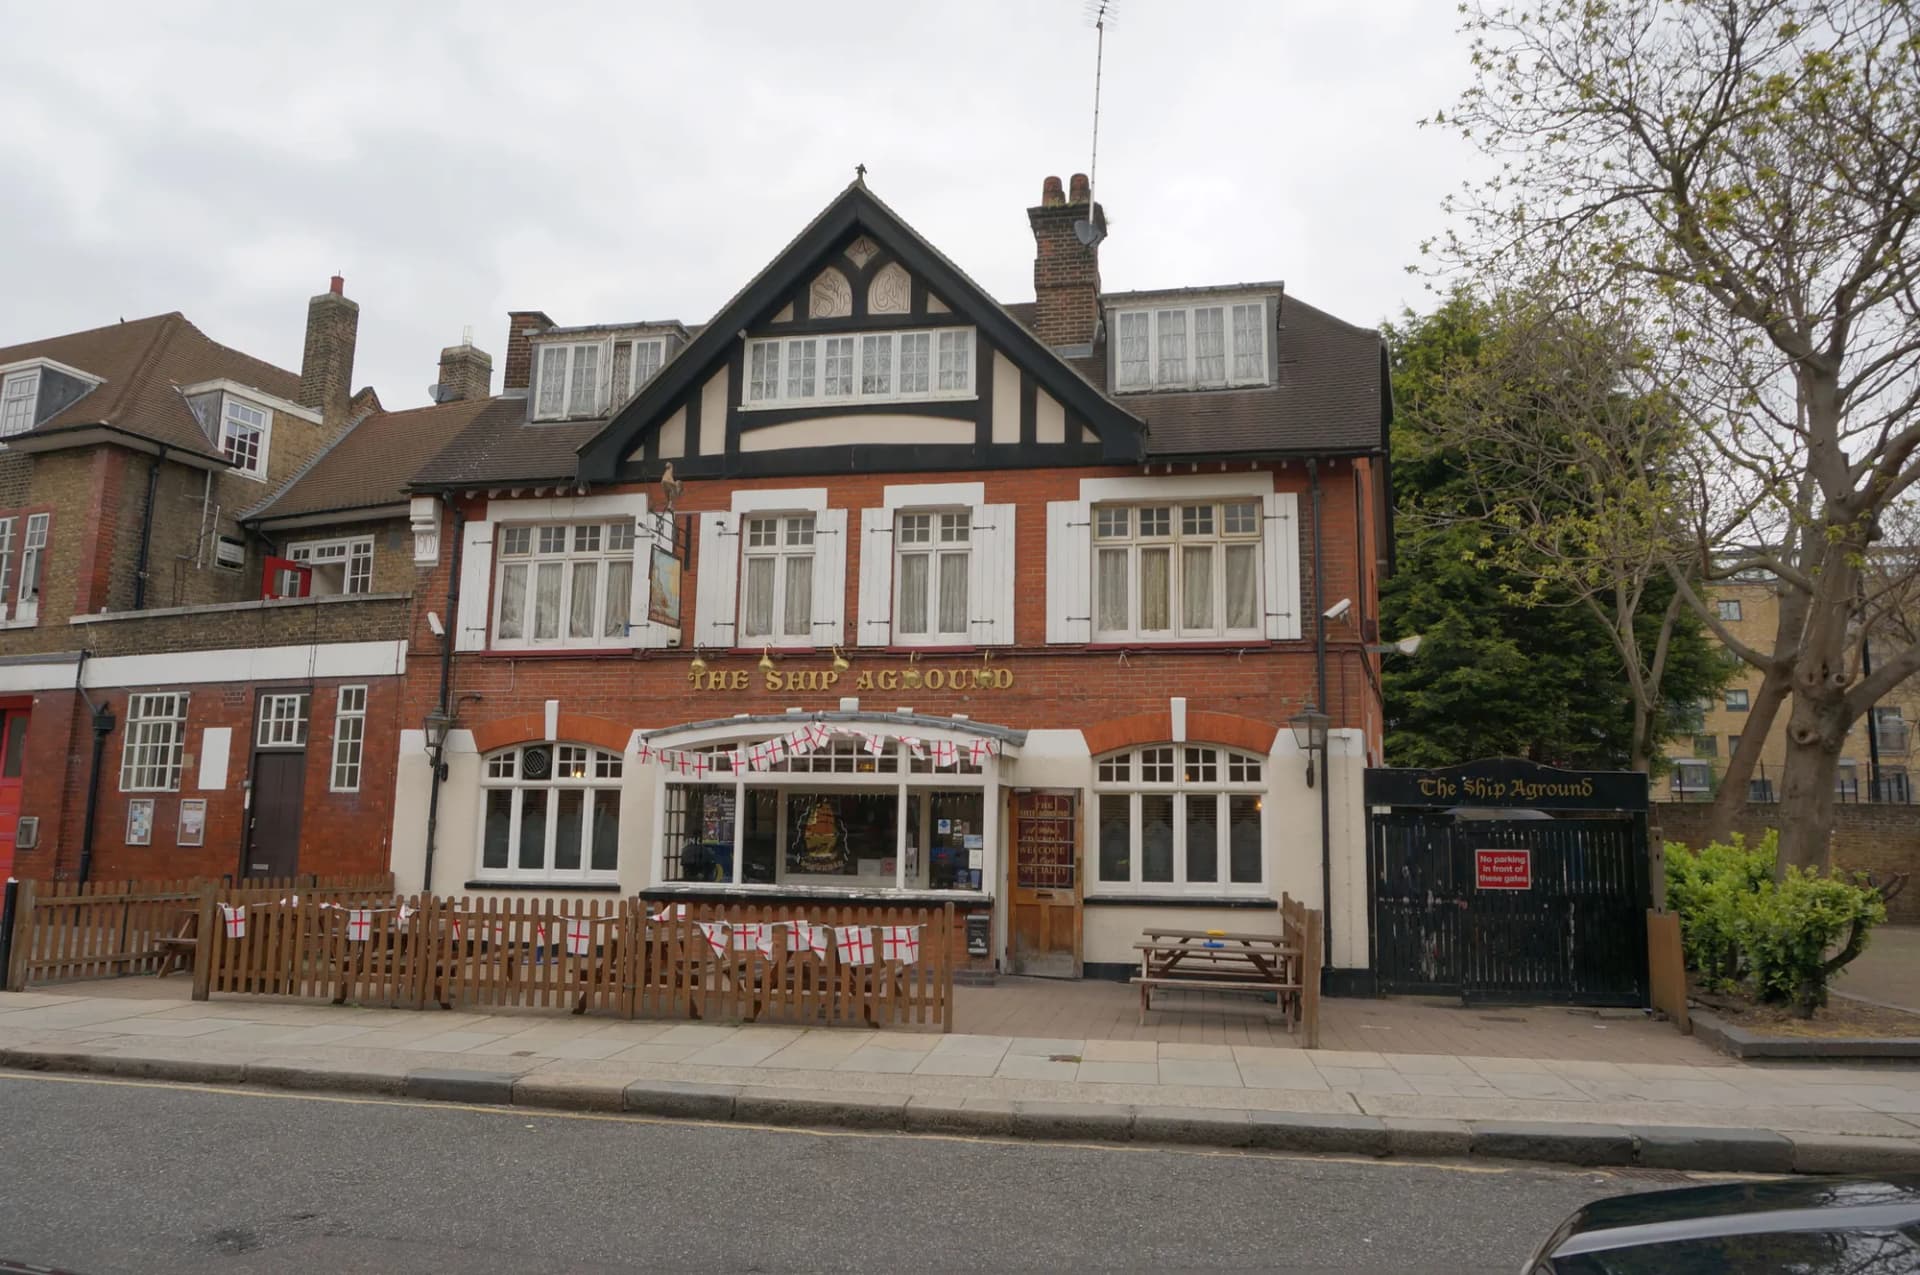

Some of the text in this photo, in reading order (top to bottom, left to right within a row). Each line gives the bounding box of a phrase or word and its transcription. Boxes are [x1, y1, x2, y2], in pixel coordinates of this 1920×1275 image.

[687, 669, 749, 691] THE
[765, 669, 838, 691] SHIP
[1417, 776, 1593, 800] The Ship Aground
[1480, 855, 1526, 864] No parking
[1493, 865, 1513, 873] front
[1504, 875, 1527, 883] gates
